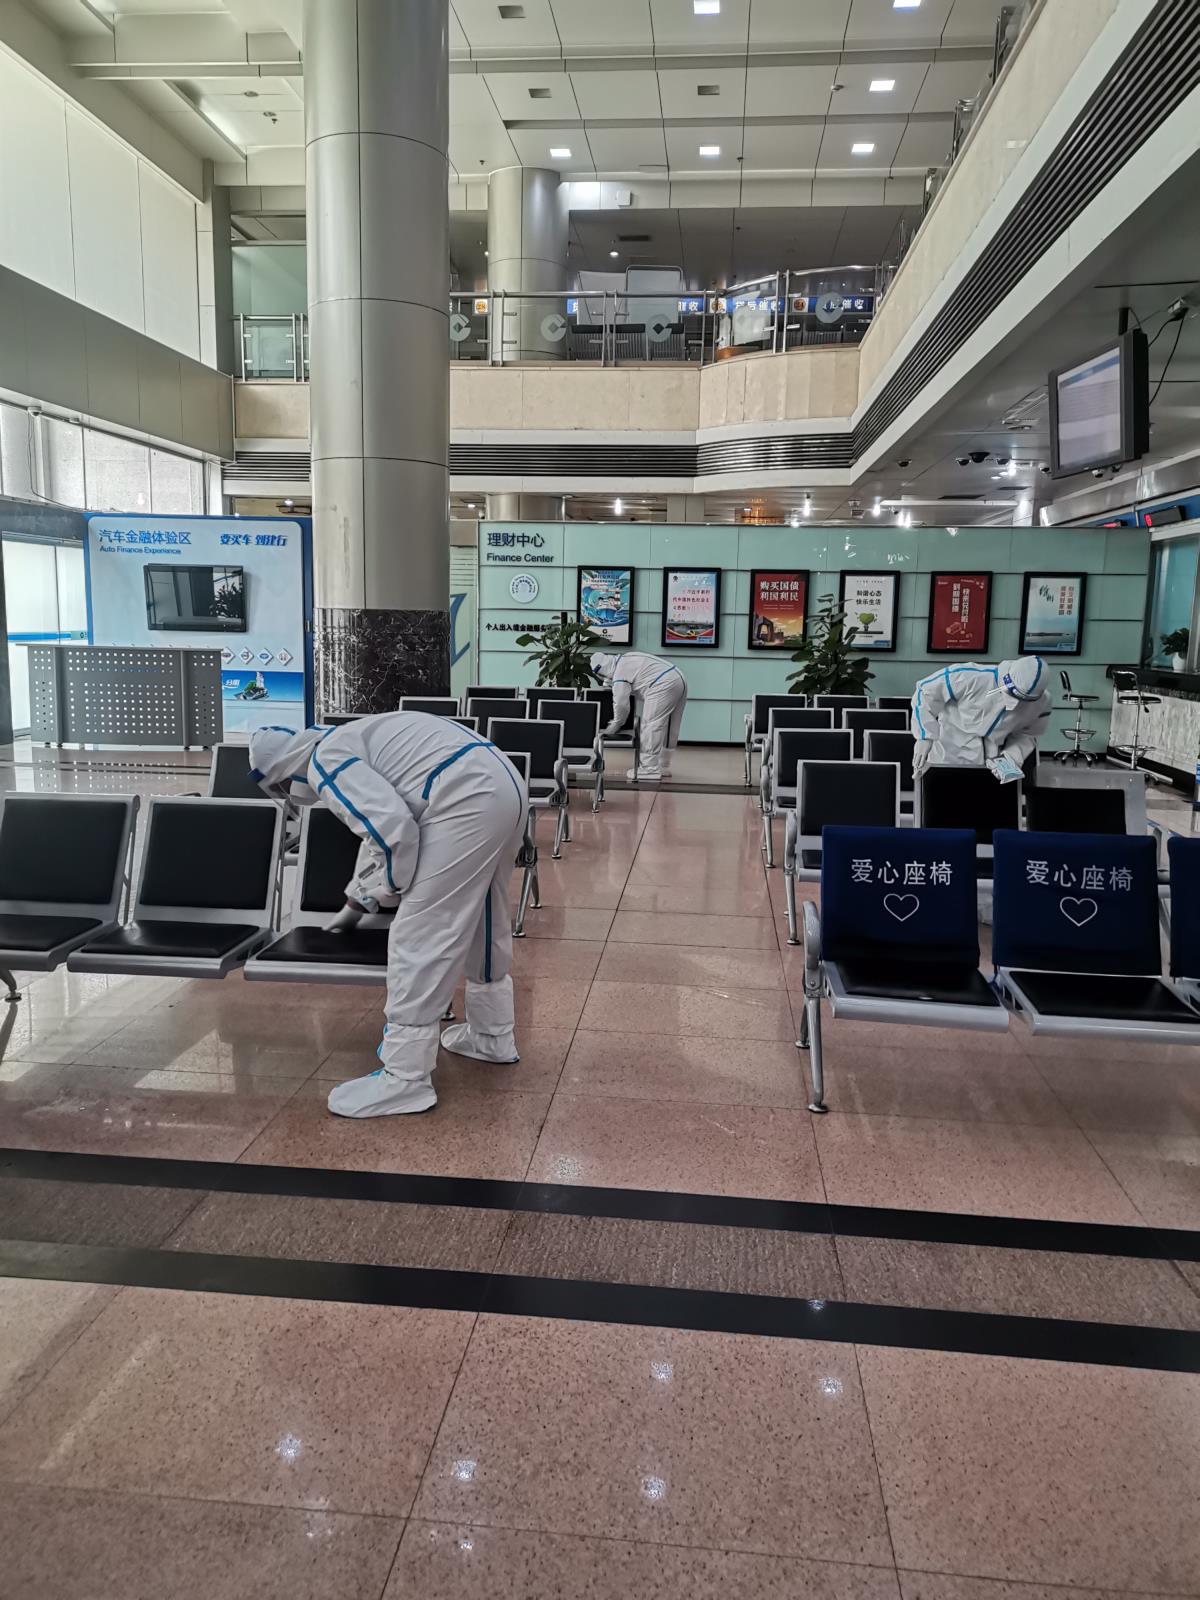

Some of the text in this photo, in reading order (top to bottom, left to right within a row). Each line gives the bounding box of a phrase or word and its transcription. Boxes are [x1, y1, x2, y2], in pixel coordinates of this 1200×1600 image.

[99, 529, 192, 545] 汽车金融体验区
[487, 532, 545, 548] 理财中心
[100, 545, 181, 555] Auto Finance Experience
[486, 552, 554, 562] Finance Center
[760, 581, 799, 591] 购买国债
[760, 591, 799, 601] 利国利民
[851, 859, 953, 886] 爱心座椅
[1026, 860, 1133, 892] 爱心座椅
